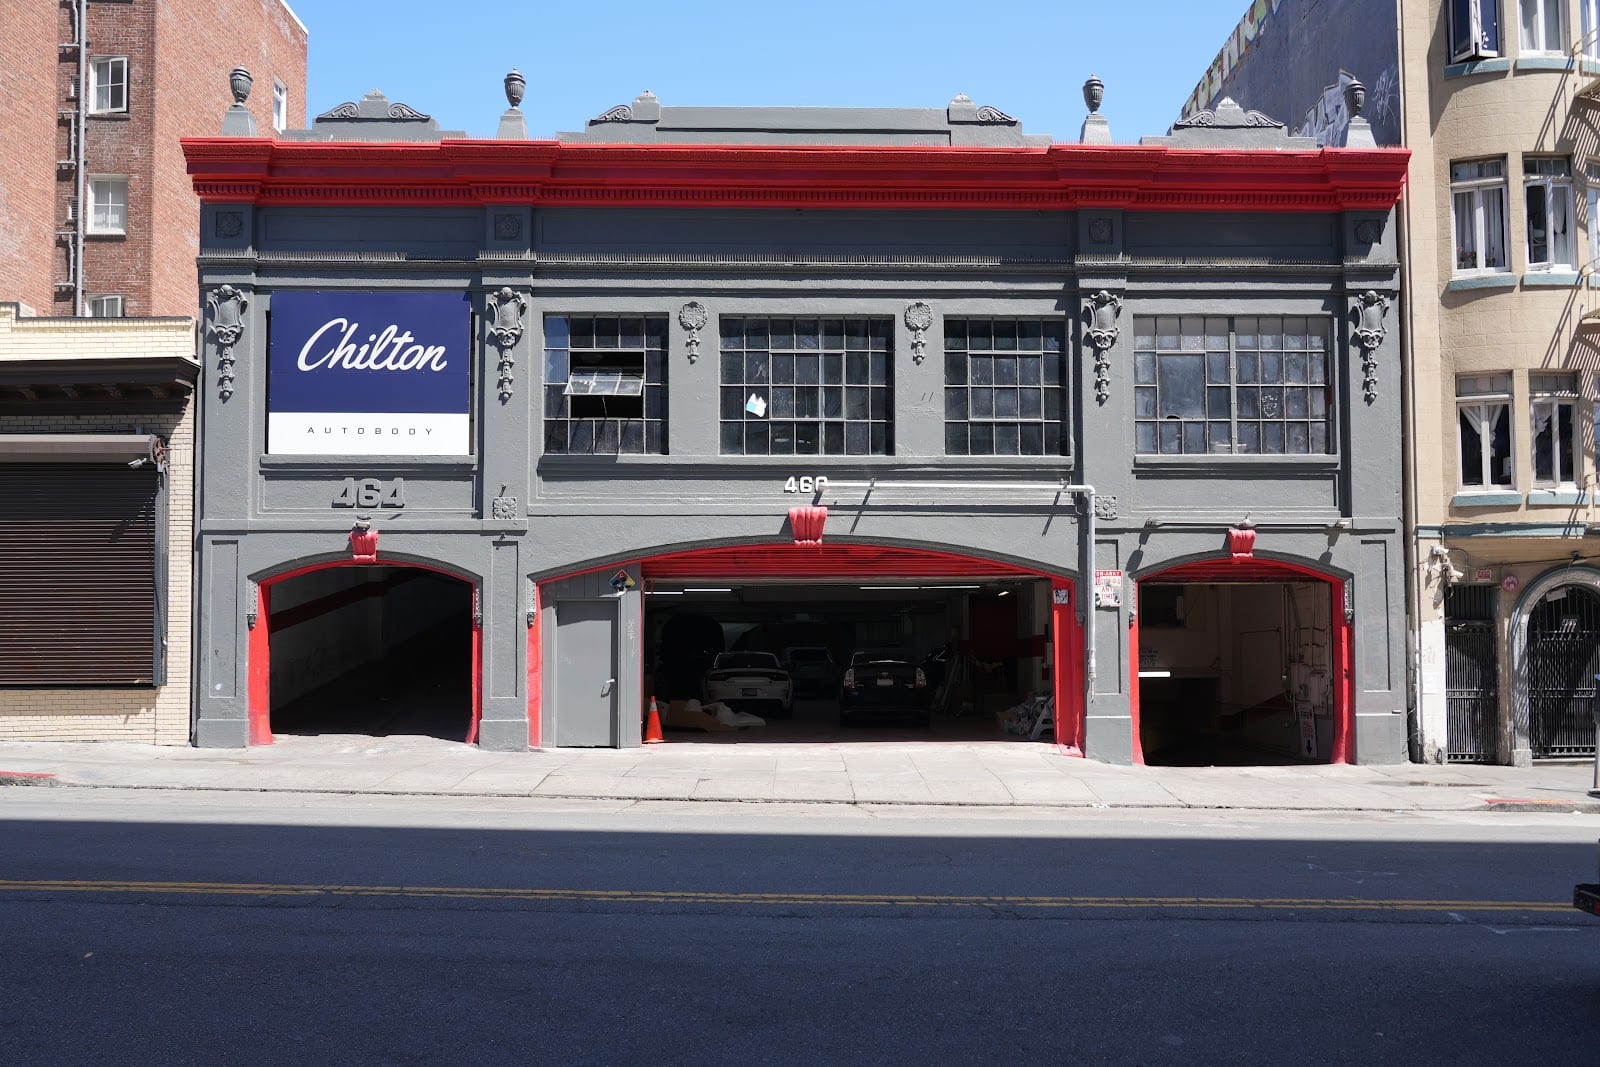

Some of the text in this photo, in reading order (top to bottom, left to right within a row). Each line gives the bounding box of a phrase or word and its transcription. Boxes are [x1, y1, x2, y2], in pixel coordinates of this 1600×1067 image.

[297, 317, 448, 372] Chilton
[307, 426, 433, 436] AUTOBODY
[332, 477, 405, 508] 464
